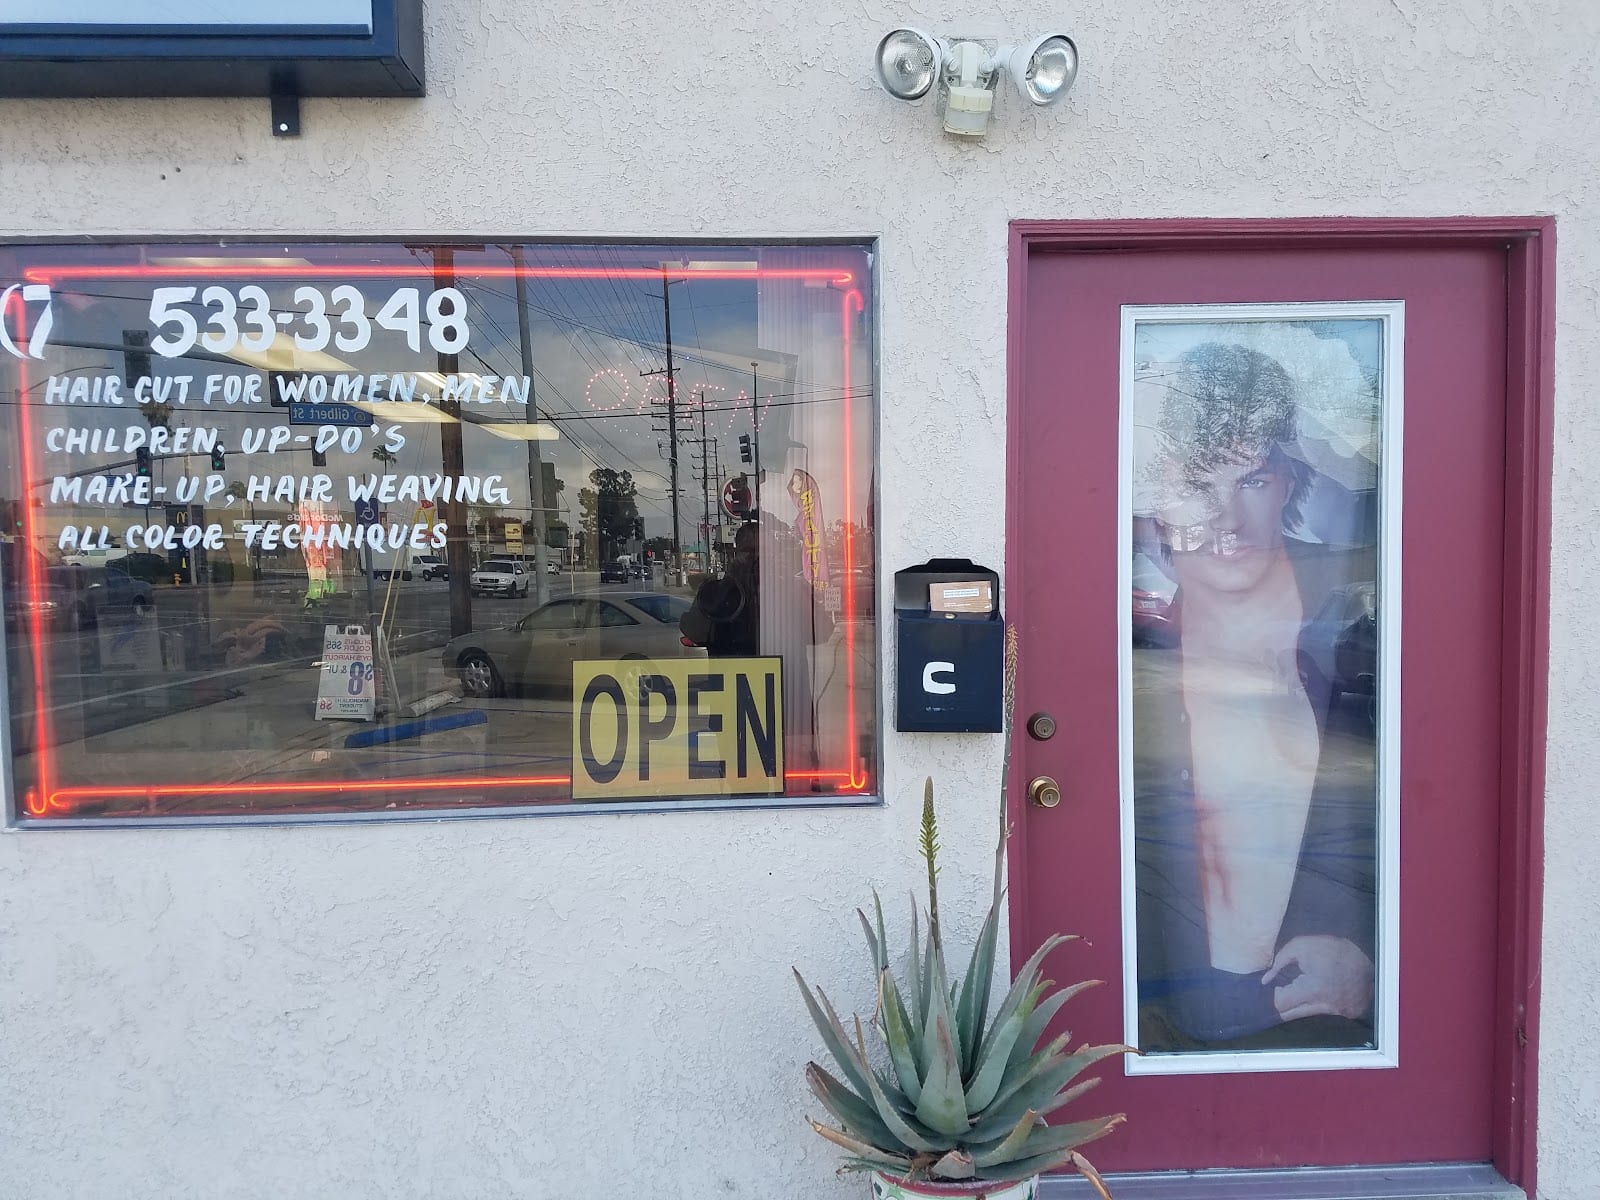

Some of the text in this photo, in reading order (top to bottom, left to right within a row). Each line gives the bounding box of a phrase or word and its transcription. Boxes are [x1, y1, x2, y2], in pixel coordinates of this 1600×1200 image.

[149, 285, 470, 358] 533-3348
[45, 373, 530, 406] HAIR CUT FOR WOMEN, MEN
[46, 424, 406, 457] CHILDREN, UP-DO'S
[246, 474, 333, 503] HAIR
[348, 473, 512, 505] WEAVING
[58, 523, 449, 553] ALL COLOR TECHNIQUES
[579, 674, 777, 784] OPEN
